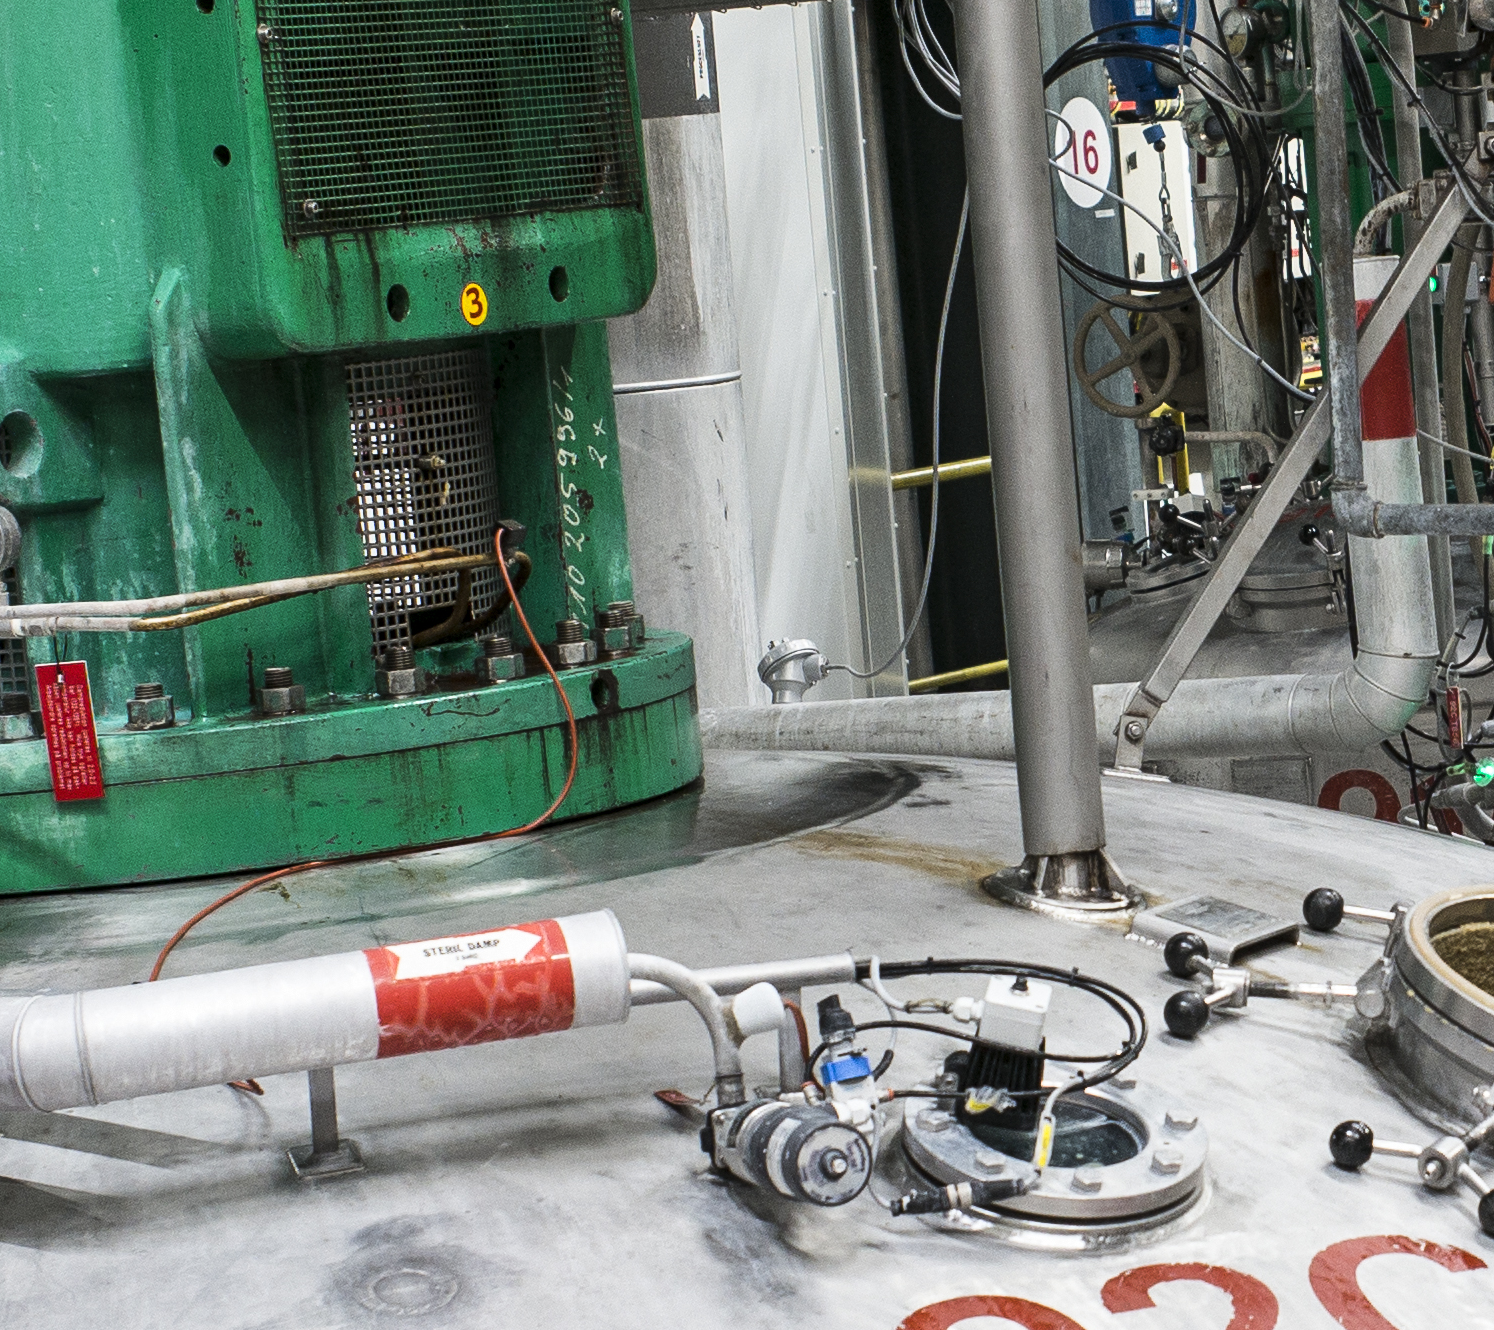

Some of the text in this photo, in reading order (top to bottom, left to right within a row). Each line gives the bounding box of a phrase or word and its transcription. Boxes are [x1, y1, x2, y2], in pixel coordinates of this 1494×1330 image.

[1069, 128, 1101, 176] 16
[464, 288, 484, 320] 3
[423, 944, 464, 958] STERIL
[467, 938, 501, 951] DAMP
